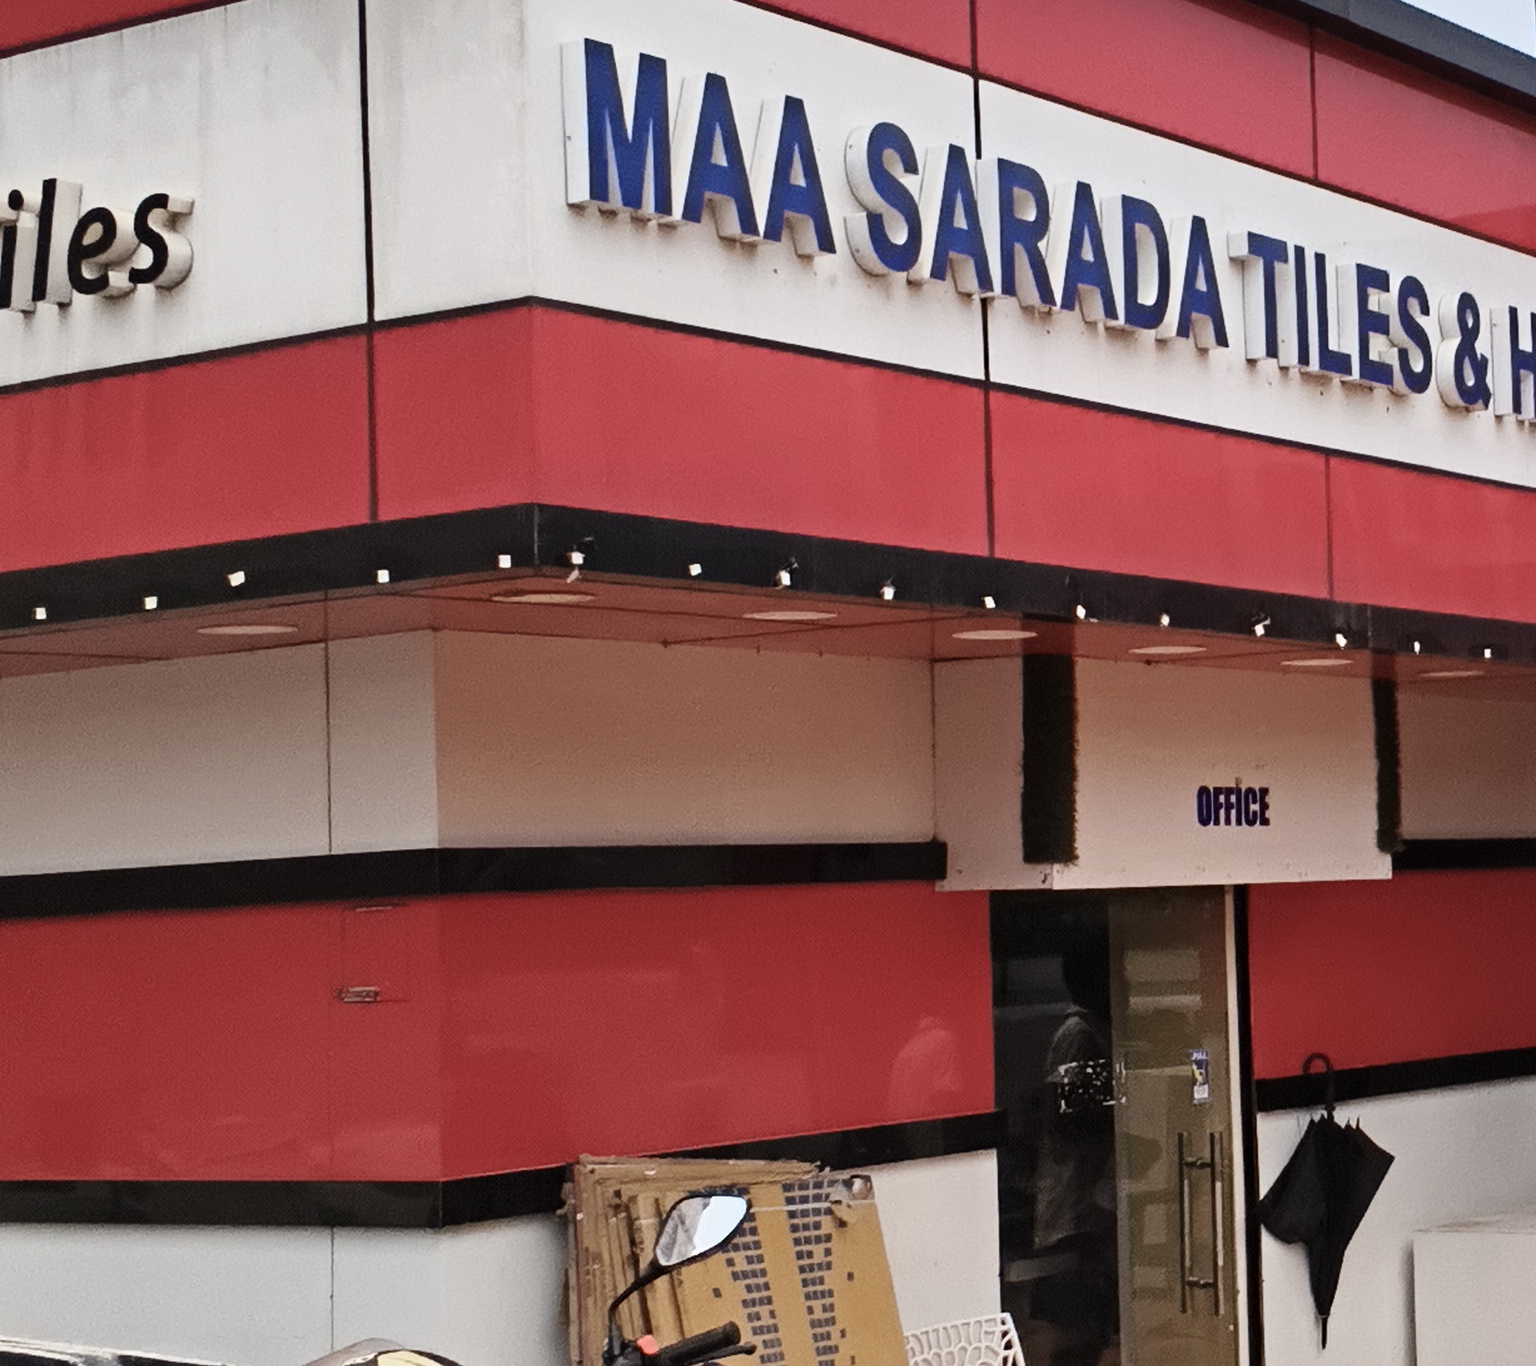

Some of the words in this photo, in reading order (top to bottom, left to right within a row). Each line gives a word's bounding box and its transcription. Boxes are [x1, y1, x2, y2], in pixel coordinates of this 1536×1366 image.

[0, 179, 194, 313] iles
[561, 37, 837, 257] MAA
[845, 121, 1231, 351] SARADA
[1227, 231, 1433, 396] TILES
[1437, 291, 1492, 412] &
[1197, 785, 1271, 827] OFFICE
